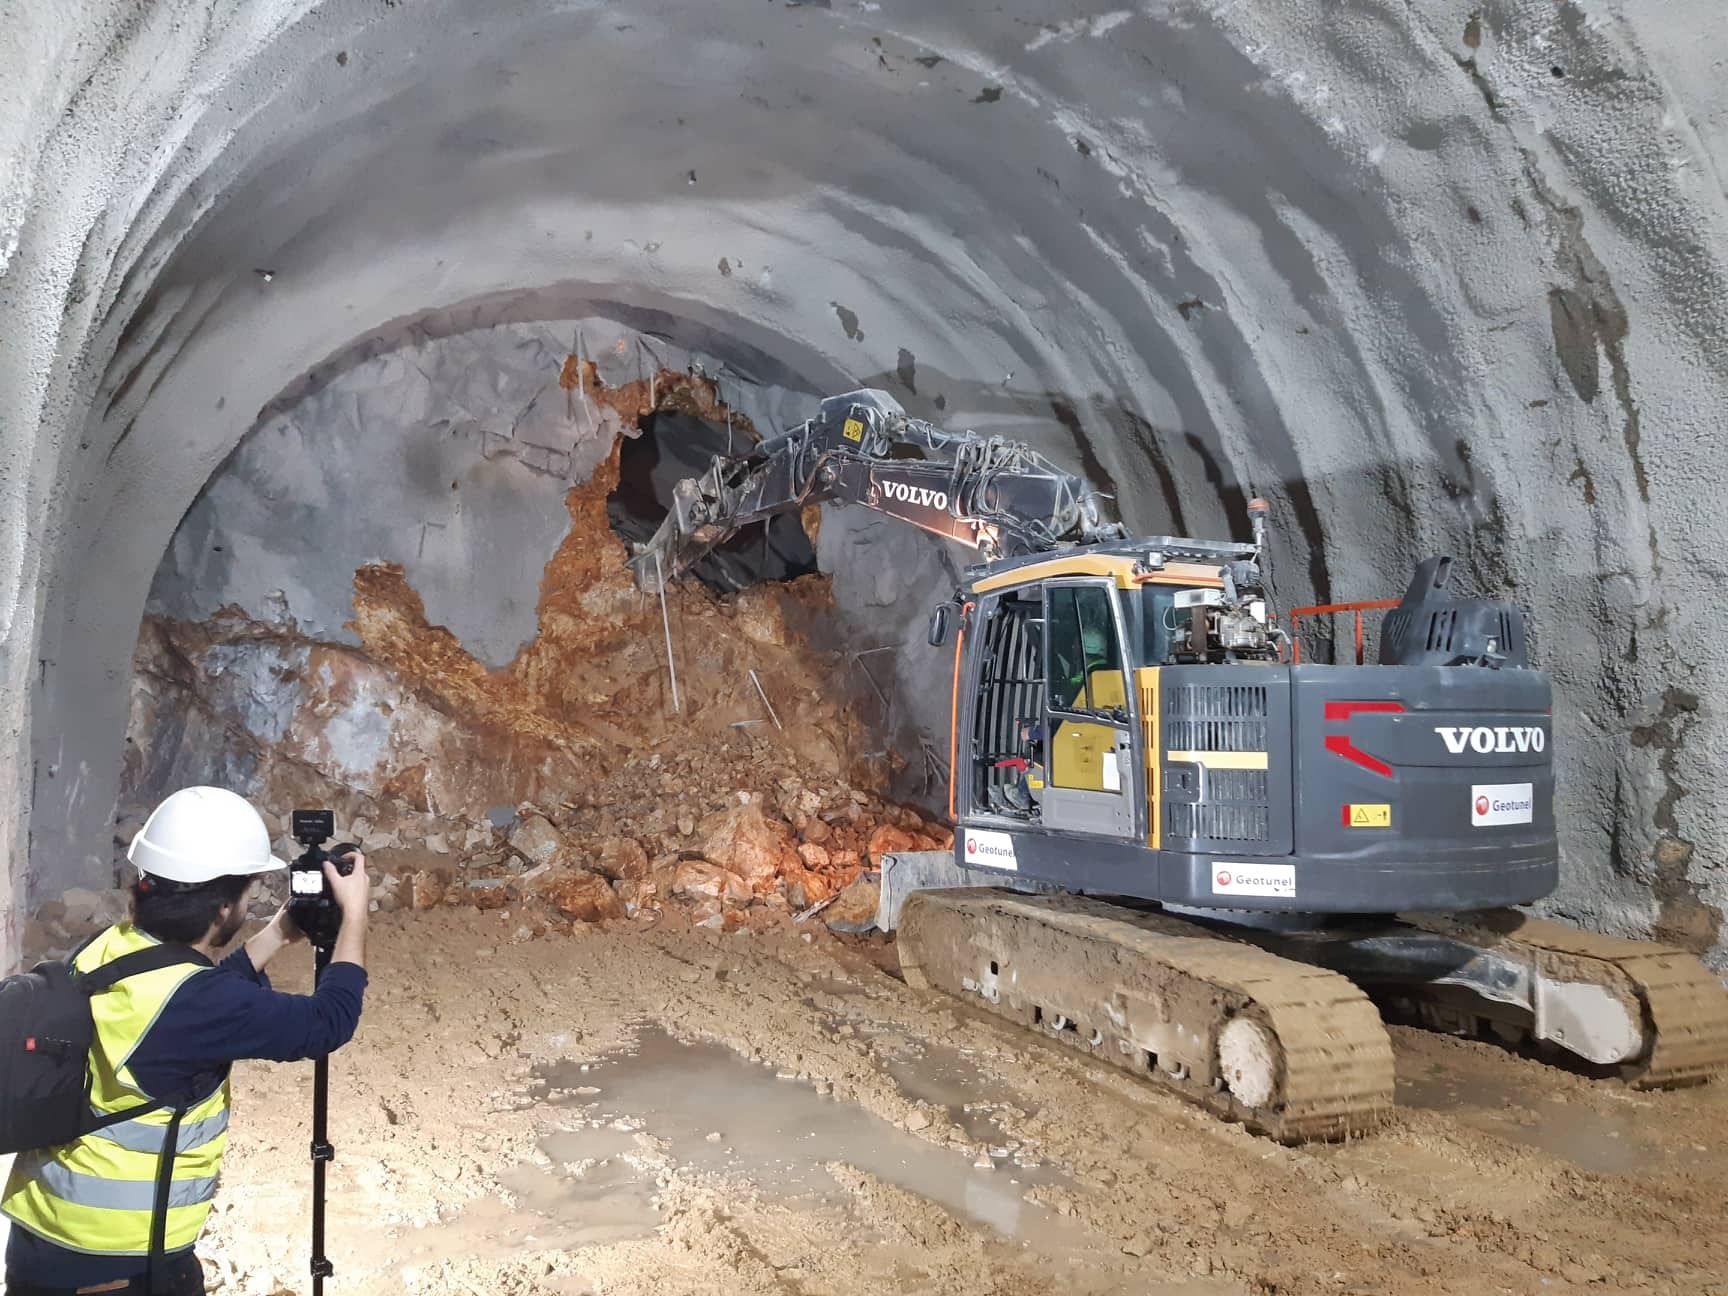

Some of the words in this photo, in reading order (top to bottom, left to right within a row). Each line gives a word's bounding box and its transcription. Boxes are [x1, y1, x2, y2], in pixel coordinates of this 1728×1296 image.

[882, 480, 948, 511] VOLVO
[1434, 726, 1545, 753] VOLVO
[1492, 796, 1532, 812] Geotunel
[978, 843, 1014, 858] Geotune
[1236, 874, 1292, 887] Geotunel
